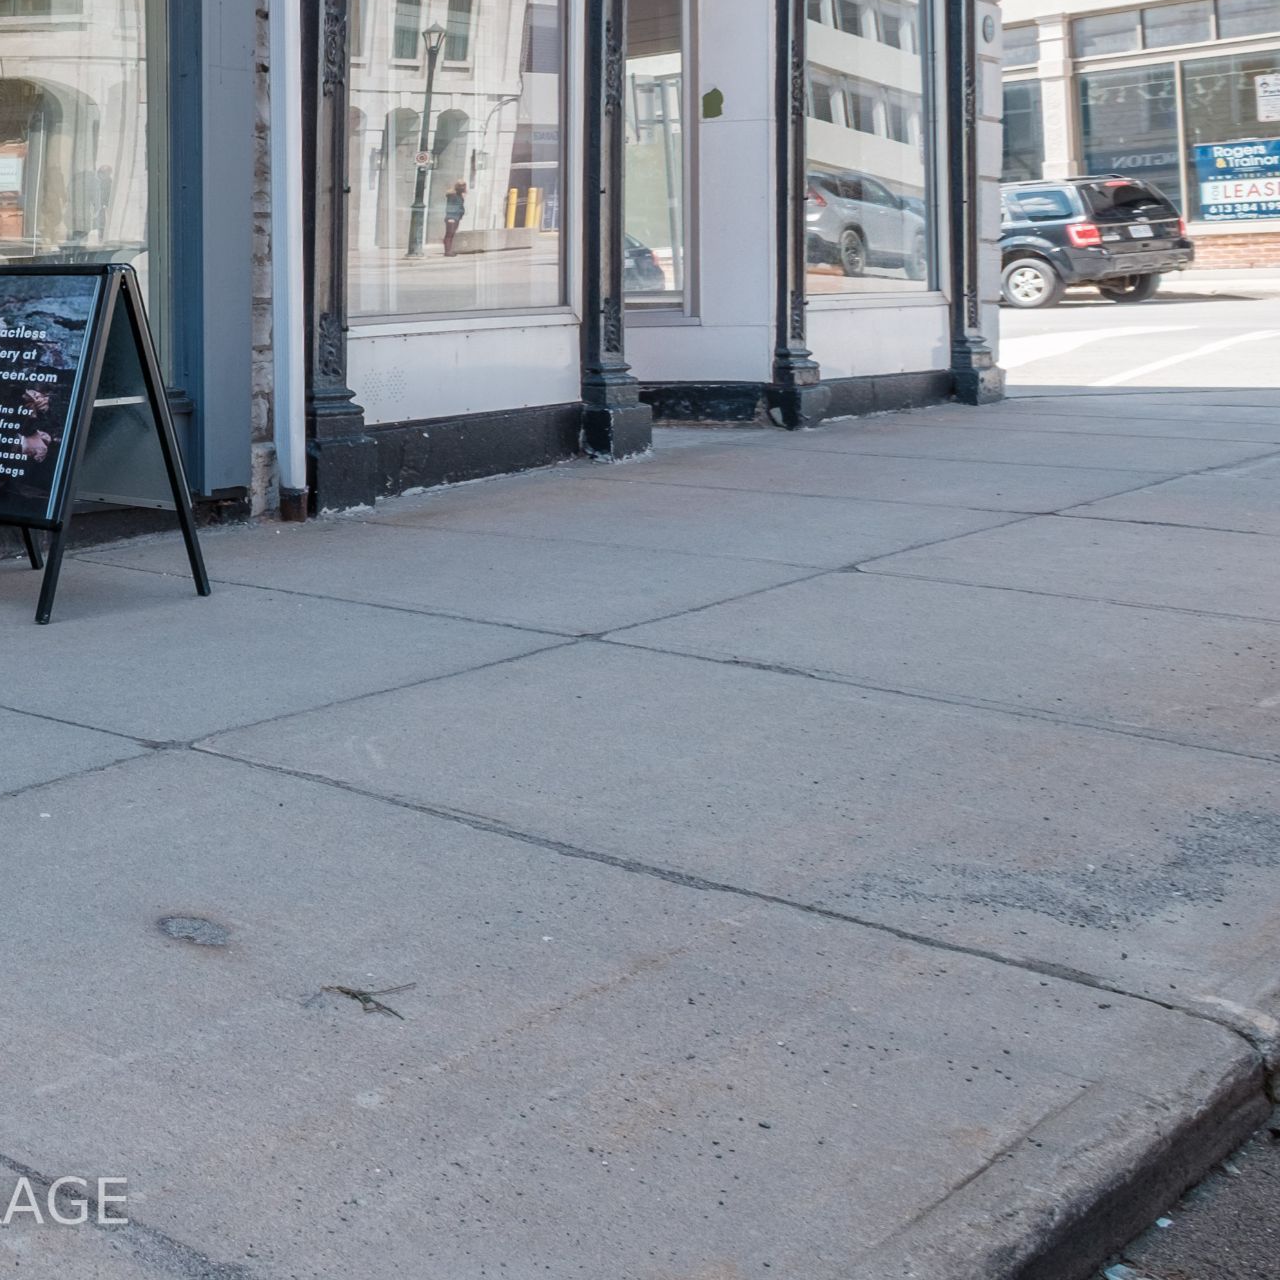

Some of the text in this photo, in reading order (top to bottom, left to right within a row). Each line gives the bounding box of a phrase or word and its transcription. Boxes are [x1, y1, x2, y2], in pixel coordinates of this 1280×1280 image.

[1213, 145, 1266, 158] Rogers
[1209, 205, 1233, 214] 613
[23, 349, 38, 360] at
[17, 405, 34, 415] for
[0, 464, 25, 477] bags
